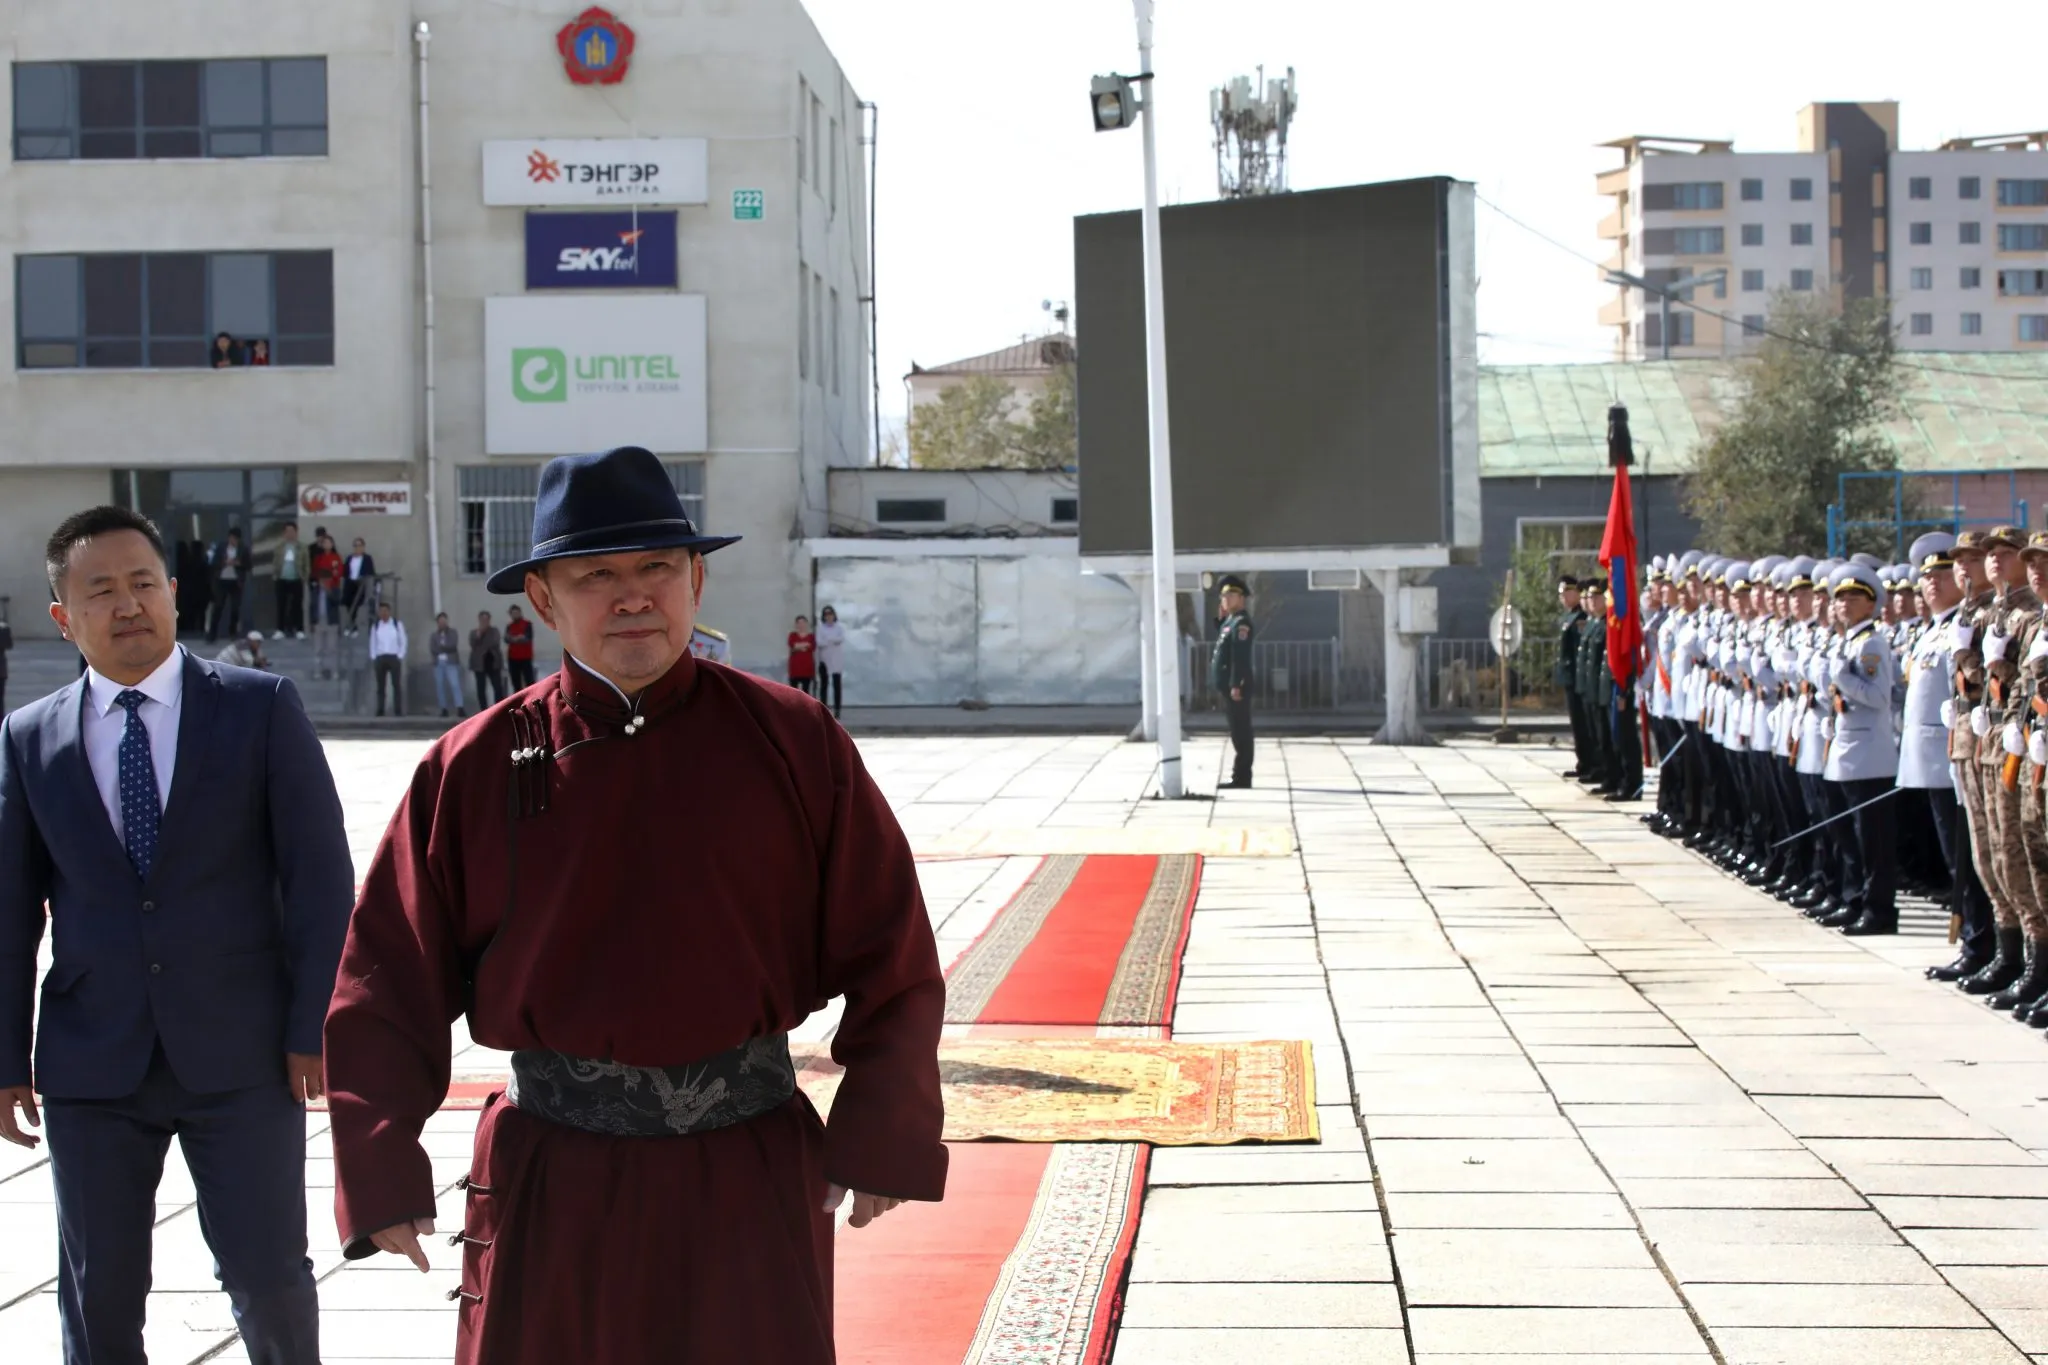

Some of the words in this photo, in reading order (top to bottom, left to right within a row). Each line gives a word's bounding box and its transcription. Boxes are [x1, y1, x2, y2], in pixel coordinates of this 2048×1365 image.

[563, 164, 659, 182] ТЭНГЭР
[734, 191, 761, 207] 222
[574, 355, 681, 380] UNITEL
